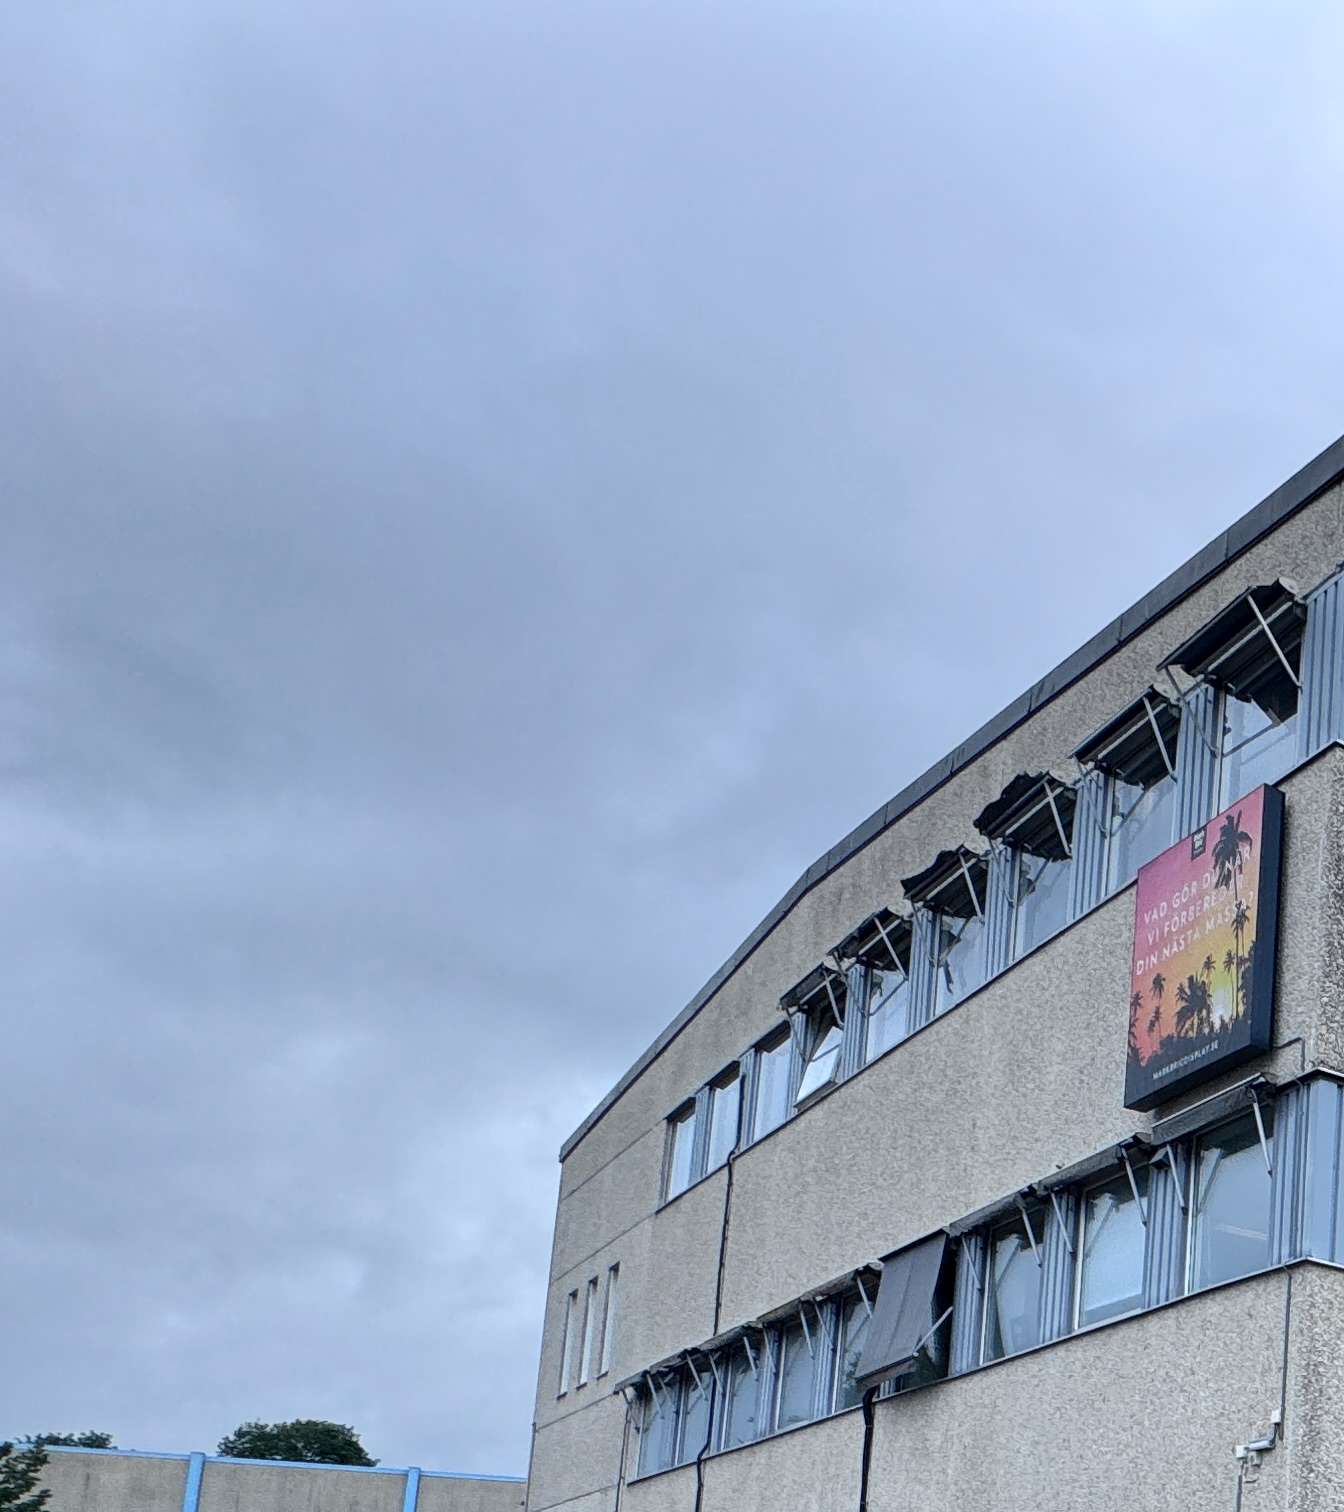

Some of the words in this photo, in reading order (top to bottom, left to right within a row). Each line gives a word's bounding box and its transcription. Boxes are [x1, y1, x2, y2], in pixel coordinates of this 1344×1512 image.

[1144, 901, 1167, 925] VAD
[1172, 880, 1197, 909] GÖR
[1136, 950, 1158, 976] DIN
[1161, 926, 1200, 961] NÄSTA
[1147, 926, 1160, 946] VI
